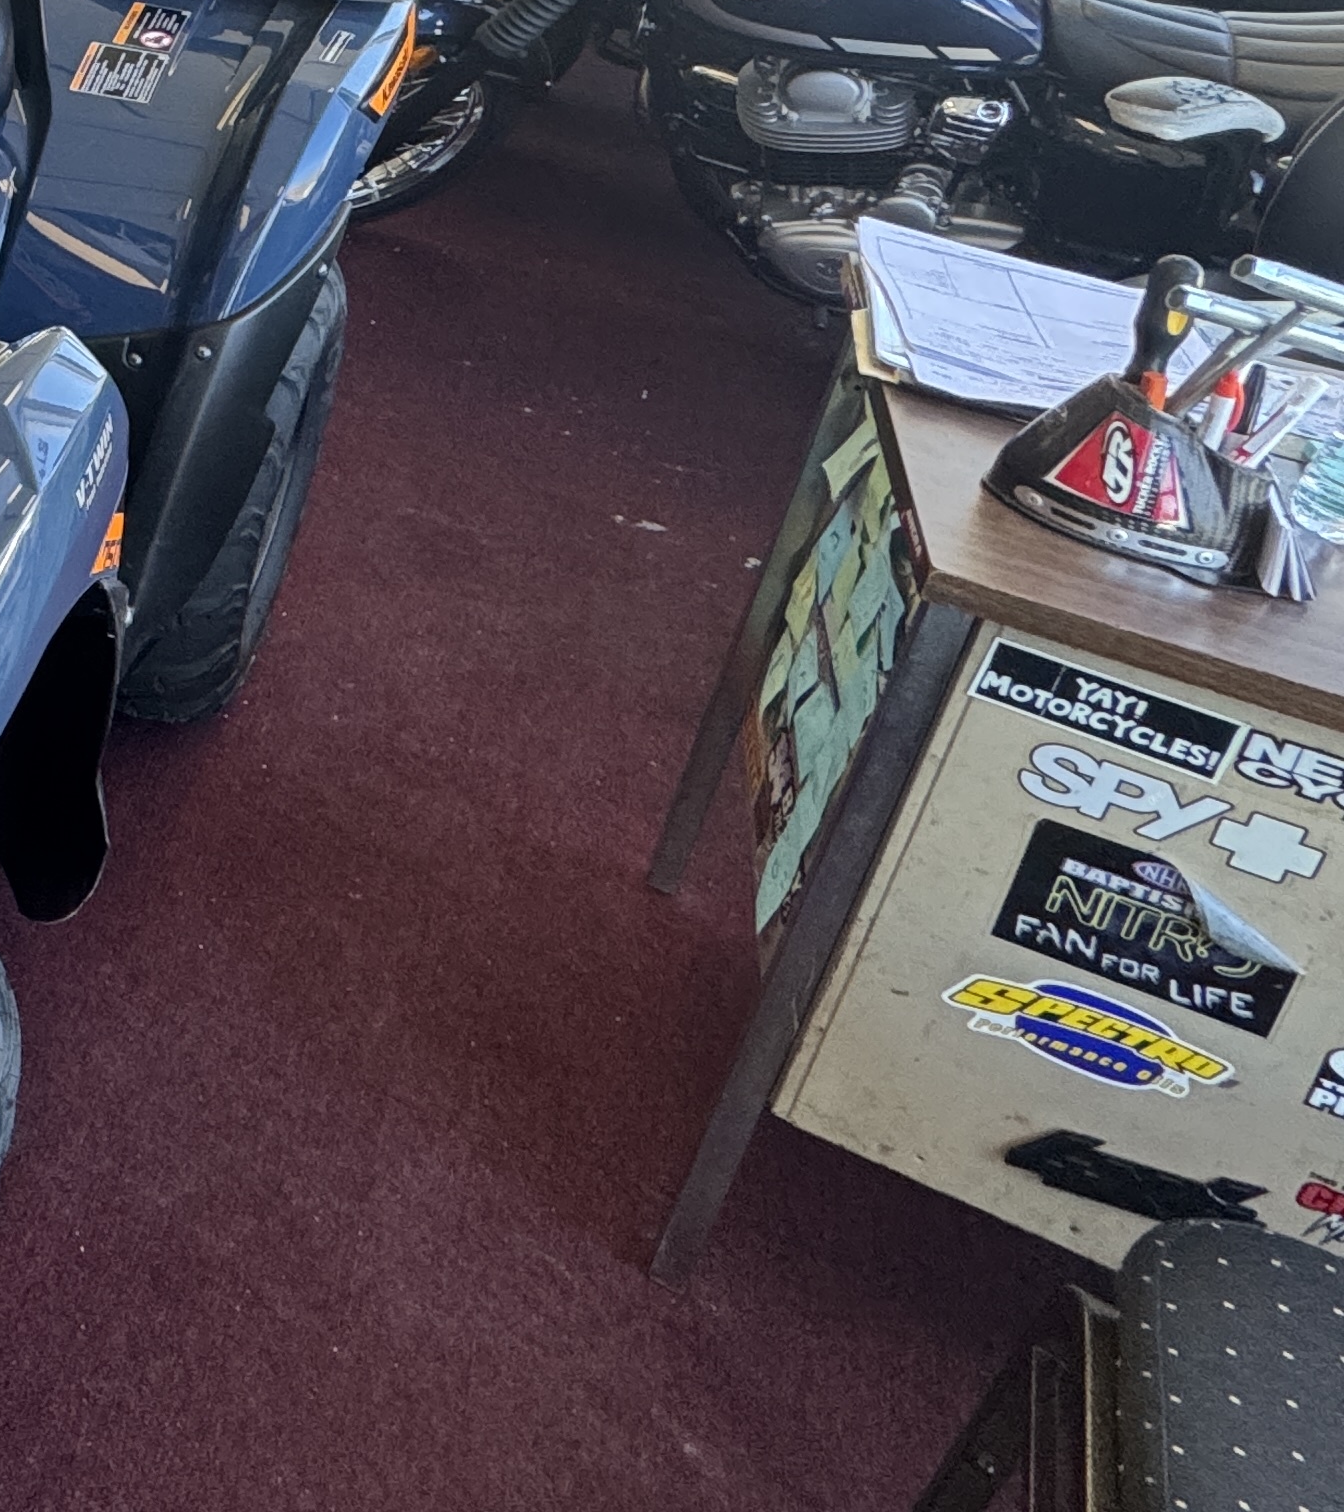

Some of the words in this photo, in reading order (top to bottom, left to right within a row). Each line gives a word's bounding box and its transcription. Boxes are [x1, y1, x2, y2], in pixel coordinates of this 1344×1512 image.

[74, 412, 115, 512] V-TWIN
[1132, 473, 1154, 516] TUCKER
[980, 670, 1222, 771] MOTORCYCLES!
[1075, 677, 1149, 720] YAY!
[1014, 914, 1099, 962] FAN
[1100, 952, 1161, 985] FOR
[1169, 978, 1255, 1020] LIFE
[948, 977, 1230, 1080] SPECTRO
